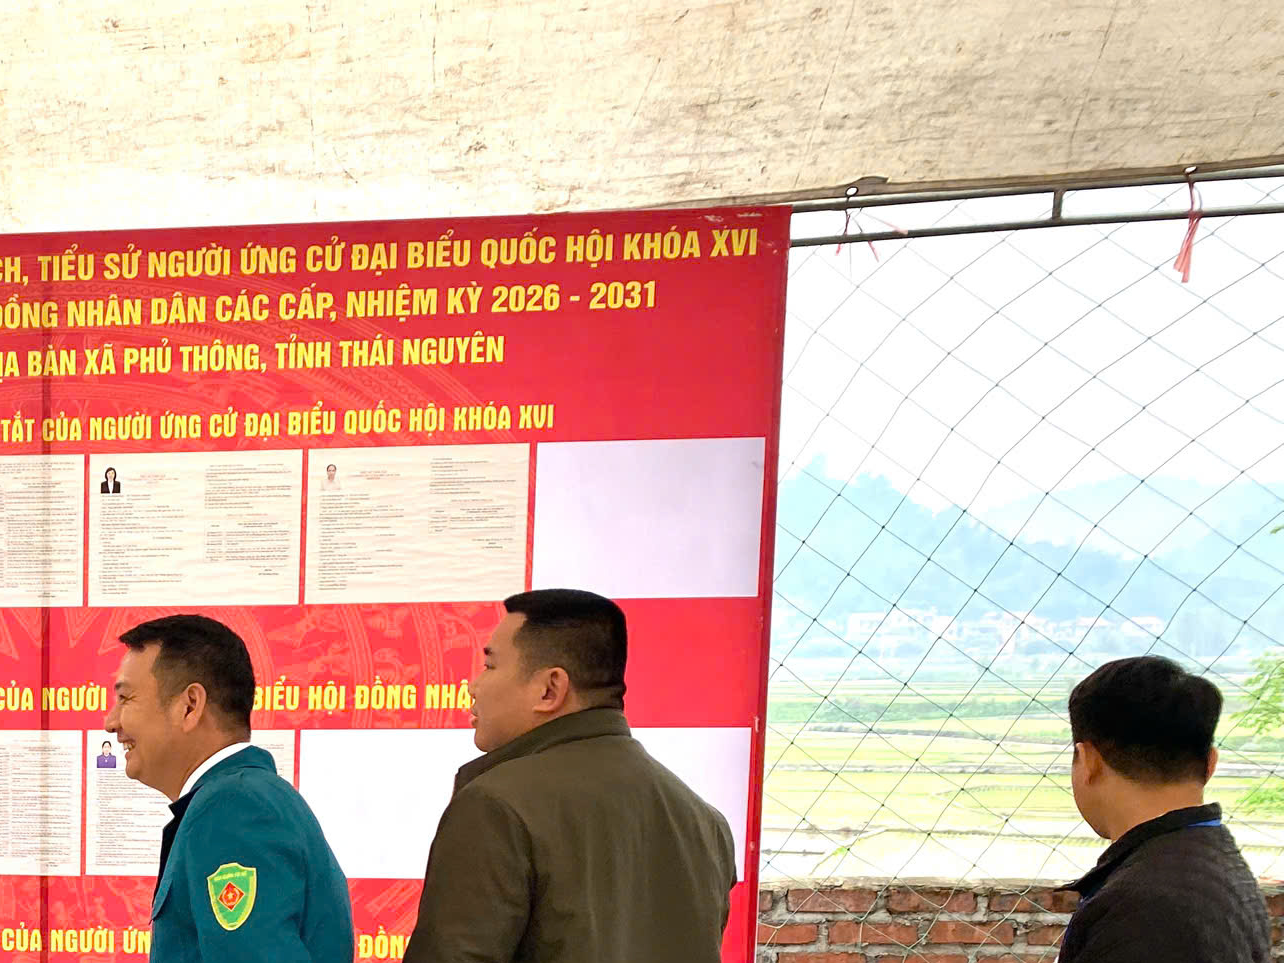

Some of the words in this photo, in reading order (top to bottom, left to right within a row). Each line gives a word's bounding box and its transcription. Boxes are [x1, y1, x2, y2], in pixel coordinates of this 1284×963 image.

[37, 243, 94, 281] TIỂU
[103, 241, 142, 280] SỬ
[147, 242, 231, 278] NGƯỜI
[240, 238, 296, 275] ỨNG
[306, 235, 346, 273] CỬ
[351, 242, 397, 276] ĐẠI
[407, 229, 471, 269] BIỂU
[480, 225, 557, 269] QUỐC
[566, 229, 613, 268] HỘI
[623, 226, 701, 260] KHÓA
[710, 228, 759, 257] XVI
[67, 292, 142, 328] NHÂN
[150, 290, 206, 325] DÂN
[215, 288, 269, 323] CÁC
[278, 282, 337, 324] CẤP,
[346, 285, 438, 322] NHIỆM
[447, 281, 483, 315] KỲ
[491, 284, 560, 313] 2026
[589, 281, 656, 310] 2031
[27, 343, 77, 377] BÀN
[83, 342, 117, 376] XÃ
[123, 338, 172, 375] PHỦ
[179, 338, 267, 374] THÔNG,
[275, 333, 331, 370] TỈNH
[339, 333, 394, 368] THÁI
[402, 330, 505, 366] NGUYÊN
[0, 408, 35, 443] TẮT
[42, 408, 82, 442] CỦA
[89, 411, 152, 441] NGƯỜI
[159, 408, 202, 440] ỨNG
[209, 405, 239, 438] CỬ
[243, 411, 280, 442] ĐẠI
[287, 400, 336, 436] BIỂU
[343, 400, 402, 438] QUỐC
[408, 402, 446, 438] HỘI
[453, 400, 511, 432] KHÓA
[518, 404, 554, 429] XVI
[42, 683, 107, 712] NGƯỜI
[253, 675, 300, 711] BIỂU
[307, 680, 346, 715] HỘI
[354, 675, 417, 711] ĐỒNG
[424, 679, 476, 710] NHÂ
[1, 921, 43, 952] CỦA
[50, 925, 115, 954] NGƯỜI
[123, 924, 153, 954] ỨN
[358, 925, 411, 959] ĐỒN
